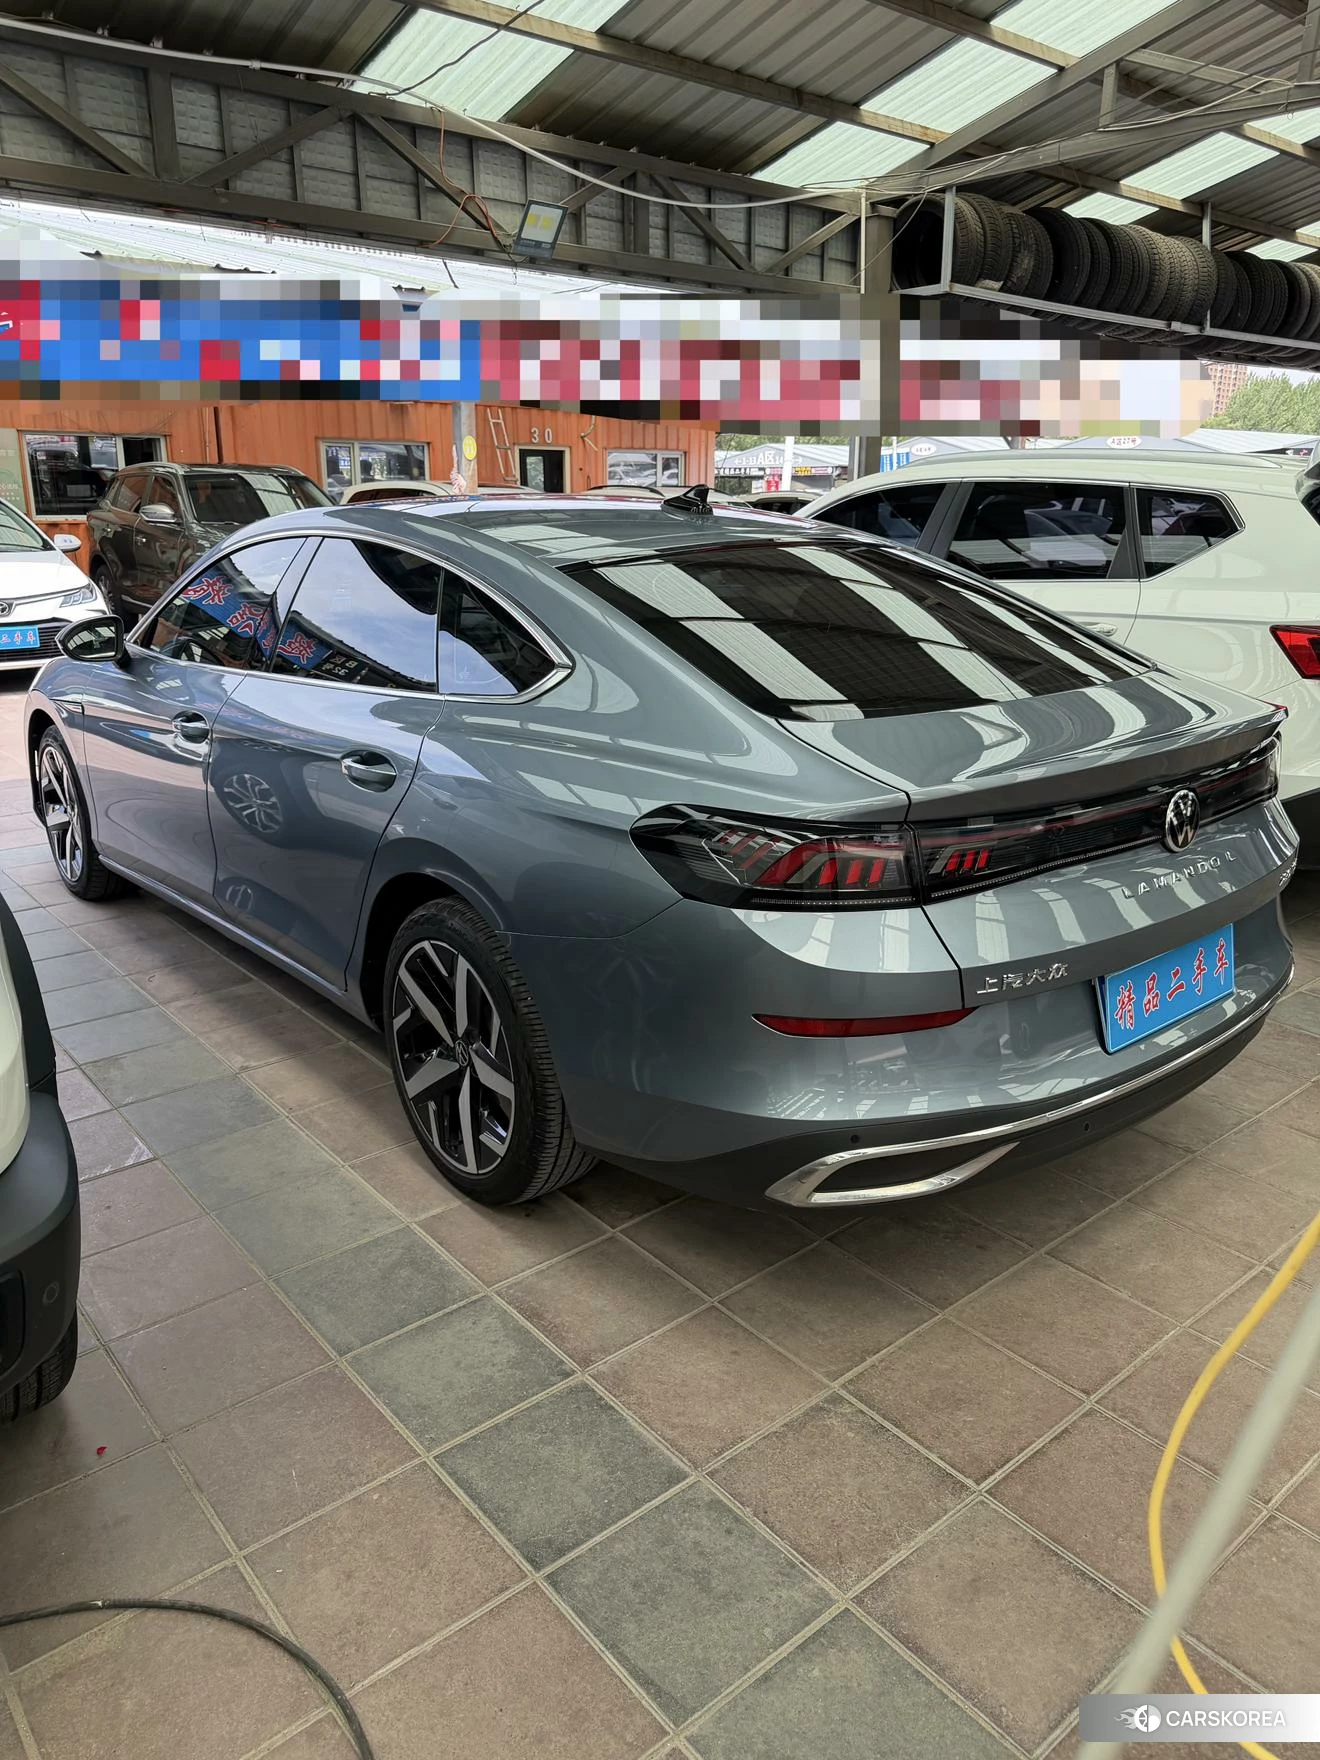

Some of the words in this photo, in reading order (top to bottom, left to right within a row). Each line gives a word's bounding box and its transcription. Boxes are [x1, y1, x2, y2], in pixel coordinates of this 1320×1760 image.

[531, 427, 553, 443] 30
[1121, 856, 1221, 899] LAMANDO
[1225, 851, 1238, 861] L
[976, 963, 1068, 994] 上汽大众
[1114, 938, 1229, 1031] 精品二手车
